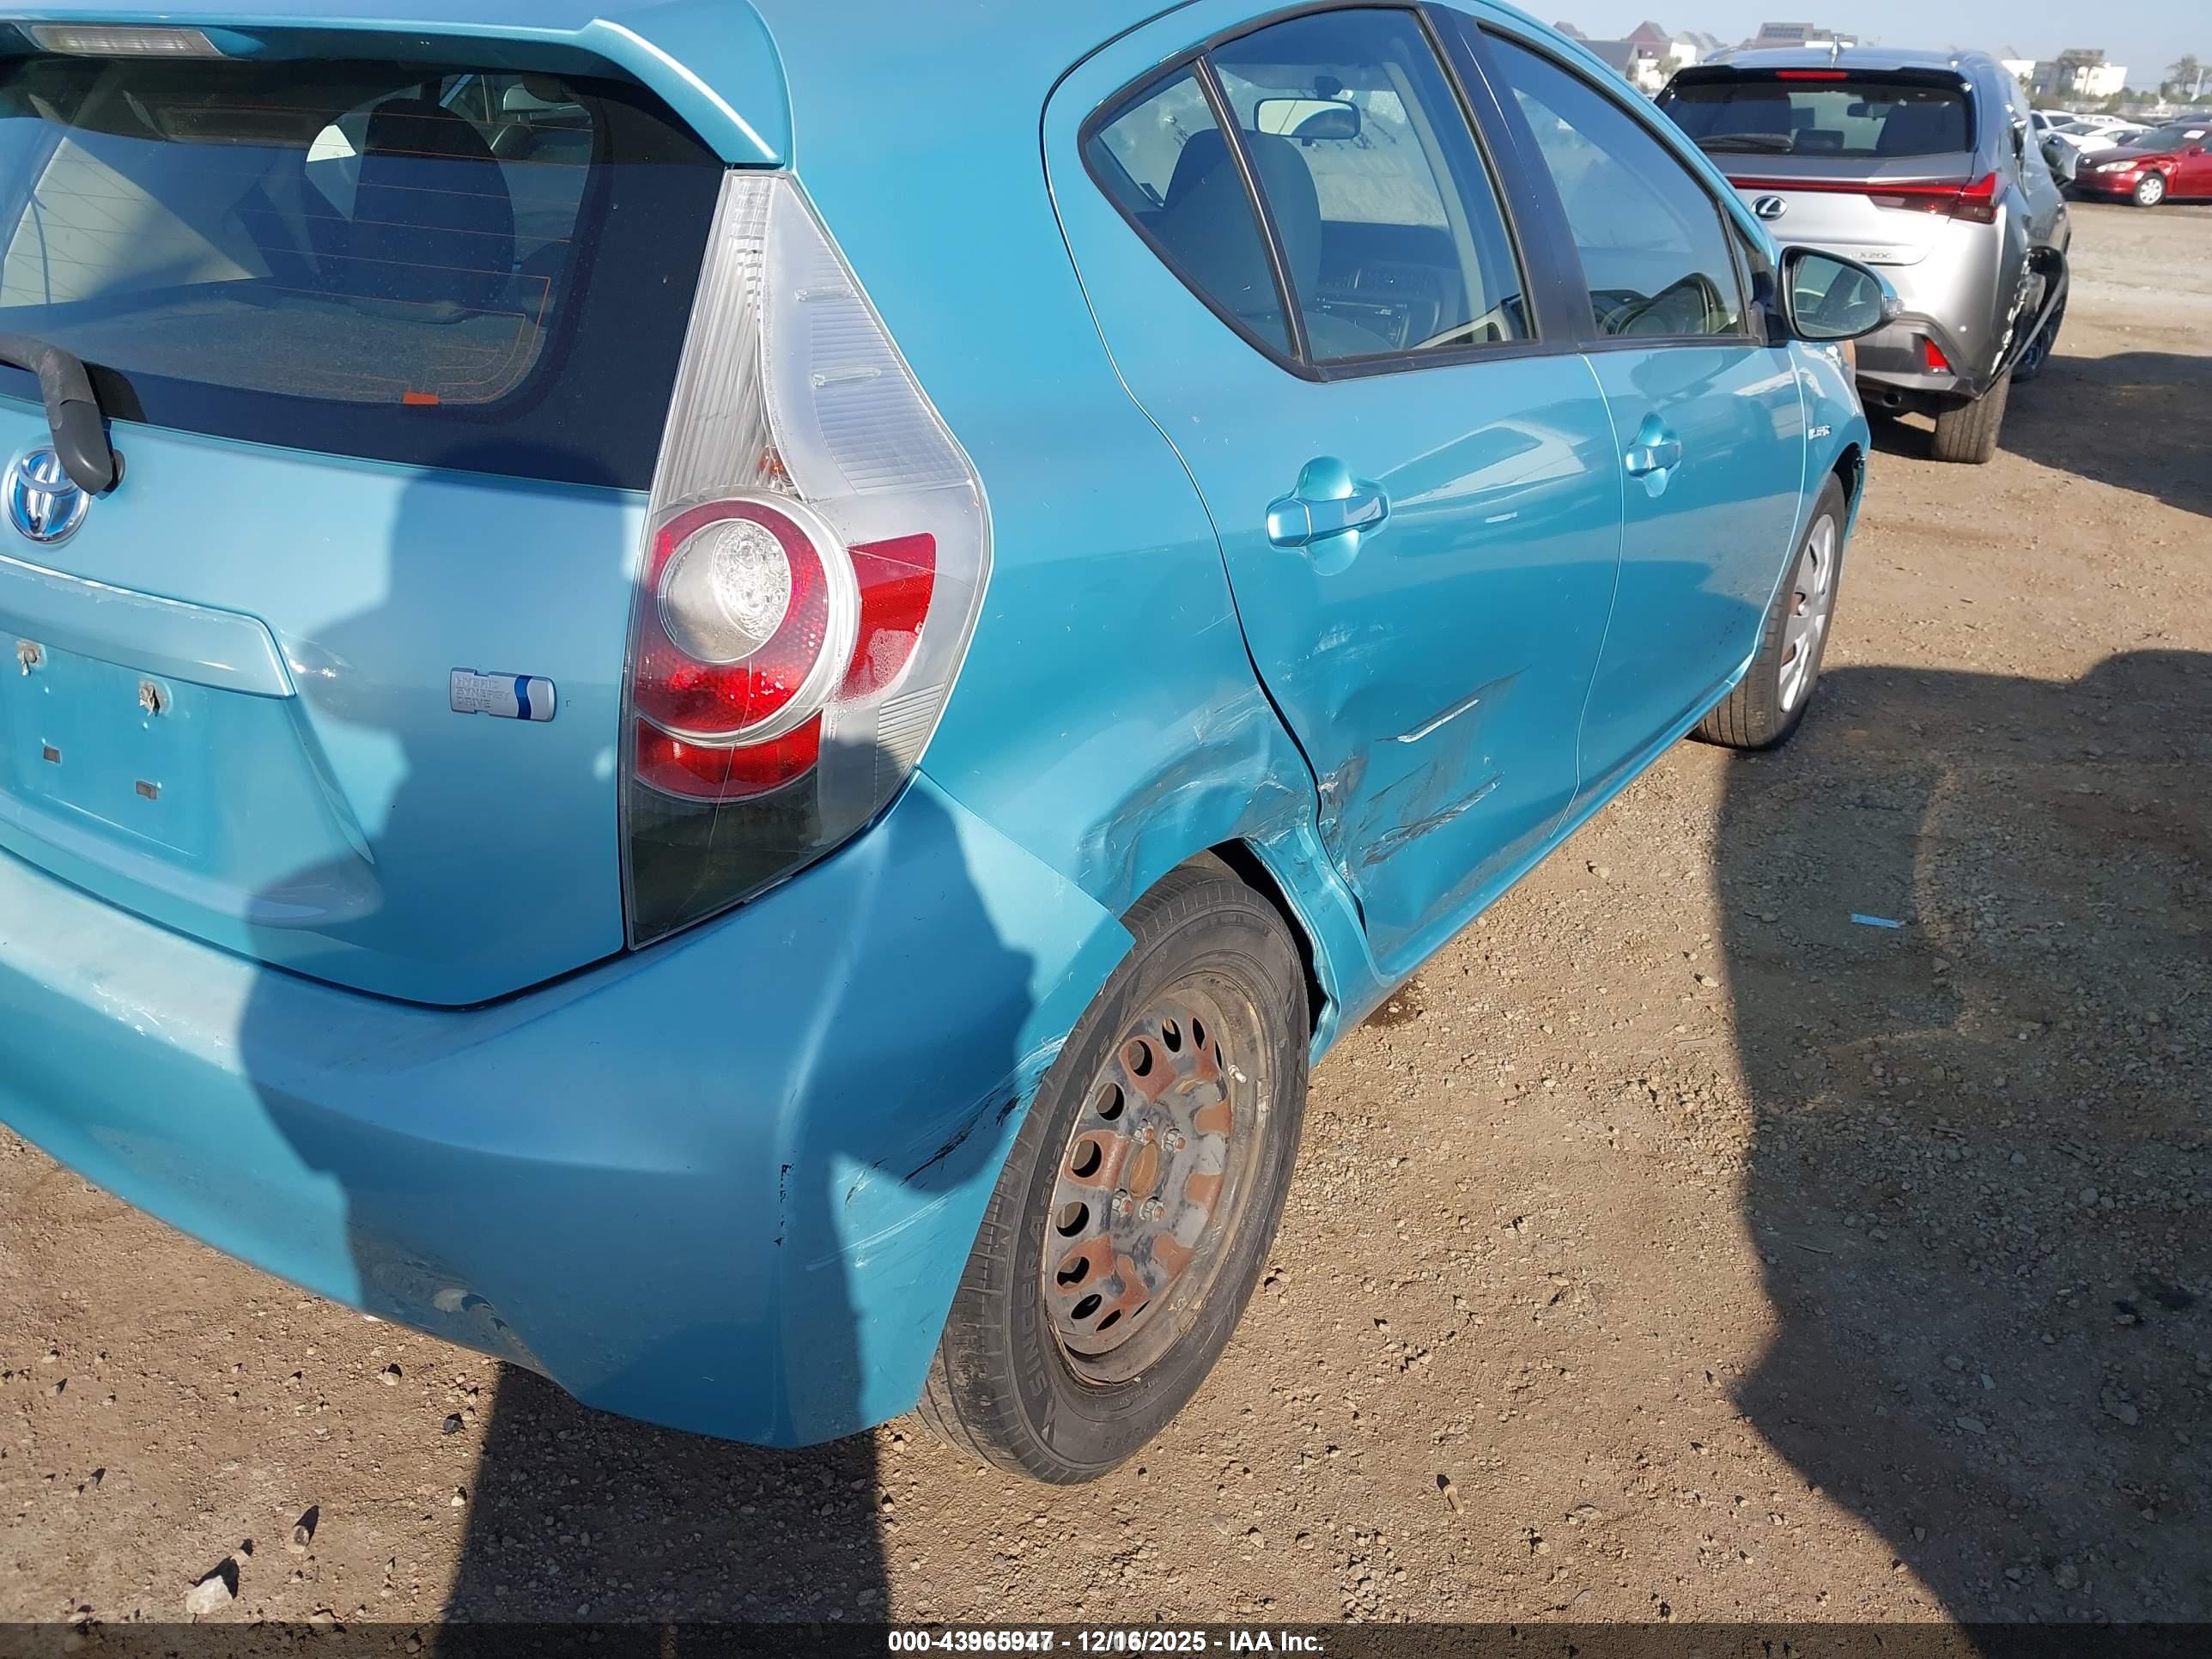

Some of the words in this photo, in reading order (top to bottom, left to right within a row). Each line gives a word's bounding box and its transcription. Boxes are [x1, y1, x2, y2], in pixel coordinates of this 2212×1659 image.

[455, 678, 501, 689] HYBRID
[456, 687, 510, 702] SYNERGY
[456, 696, 492, 708] DRIVE
[1021, 1214, 1047, 1397] SINCERA
